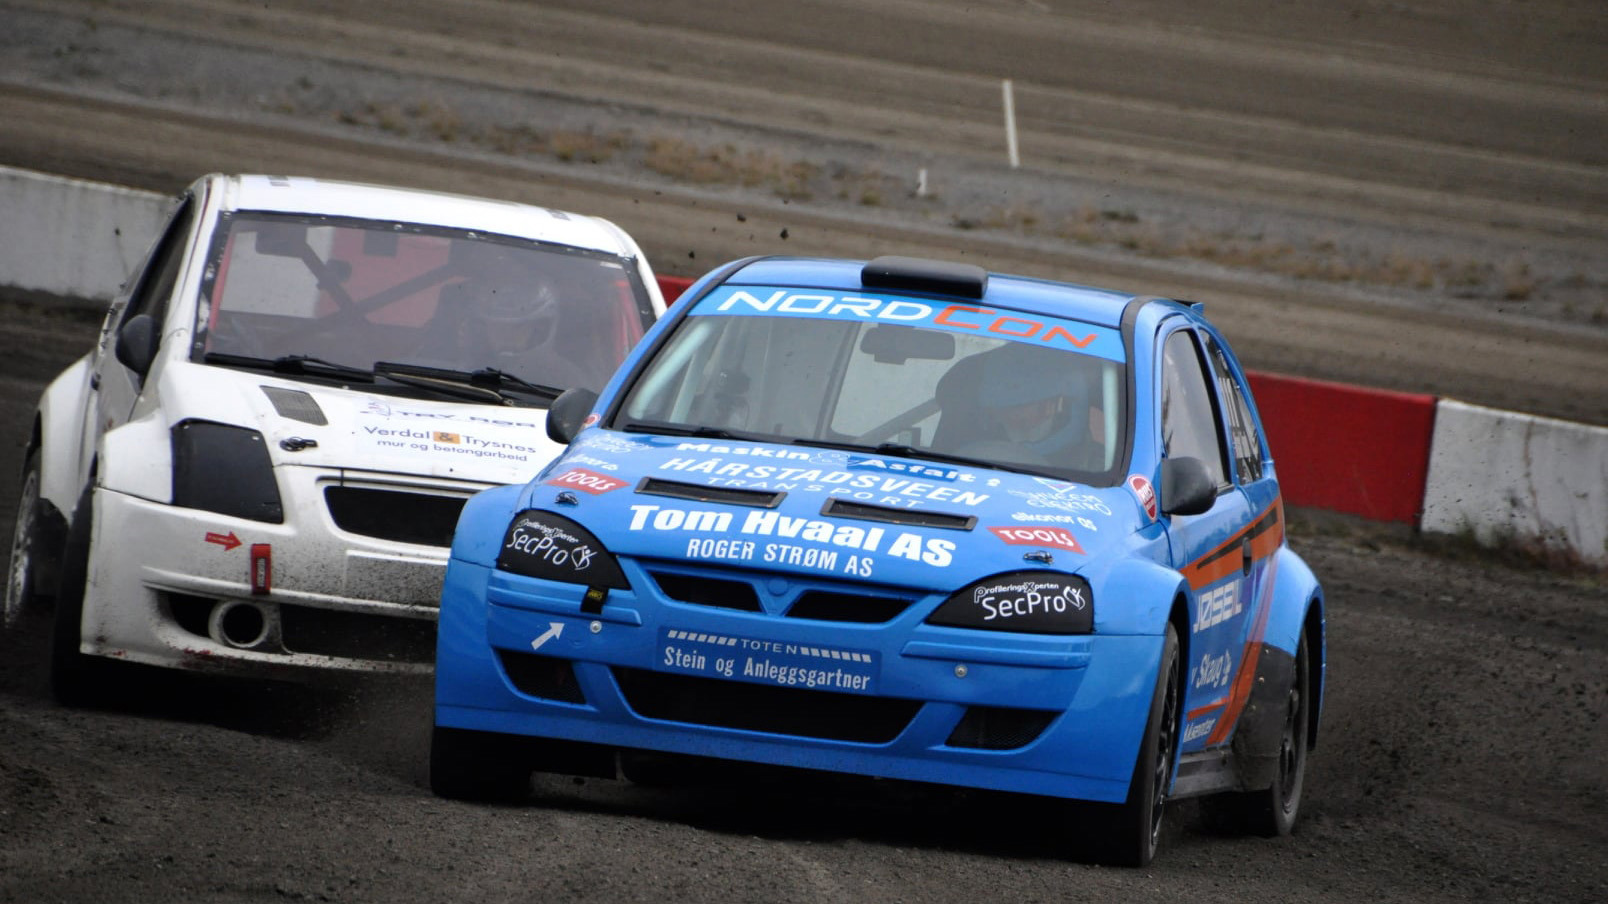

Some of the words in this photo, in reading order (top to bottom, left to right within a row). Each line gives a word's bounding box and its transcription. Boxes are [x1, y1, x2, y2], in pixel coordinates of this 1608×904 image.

[364, 426, 430, 440] Verdal
[438, 432, 454, 443] &
[462, 435, 537, 453] Trysnes
[377, 439, 406, 448] mur
[411, 443, 428, 451] og
[433, 444, 528, 462] betongarbeid
[676, 443, 811, 460] Maskin
[850, 458, 977, 483] Asfalt
[558, 472, 617, 490] TOOLS
[659, 458, 990, 506] HÅRSTADSVEEN
[707, 477, 925, 508] TRANSPORT
[506, 528, 569, 566] SecPro
[629, 505, 734, 531] Tom
[741, 511, 885, 552] Hvaal
[888, 533, 957, 568] AS
[998, 529, 1075, 547] TOOLS
[686, 539, 756, 560] ROGER
[764, 544, 839, 571] STRØM
[844, 555, 874, 578] AS
[981, 592, 1067, 621] SecPro
[740, 638, 798, 655] TOTEN
[663, 646, 706, 670] Stein
[715, 658, 735, 677] og
[743, 657, 871, 690] Anleggsgartner
